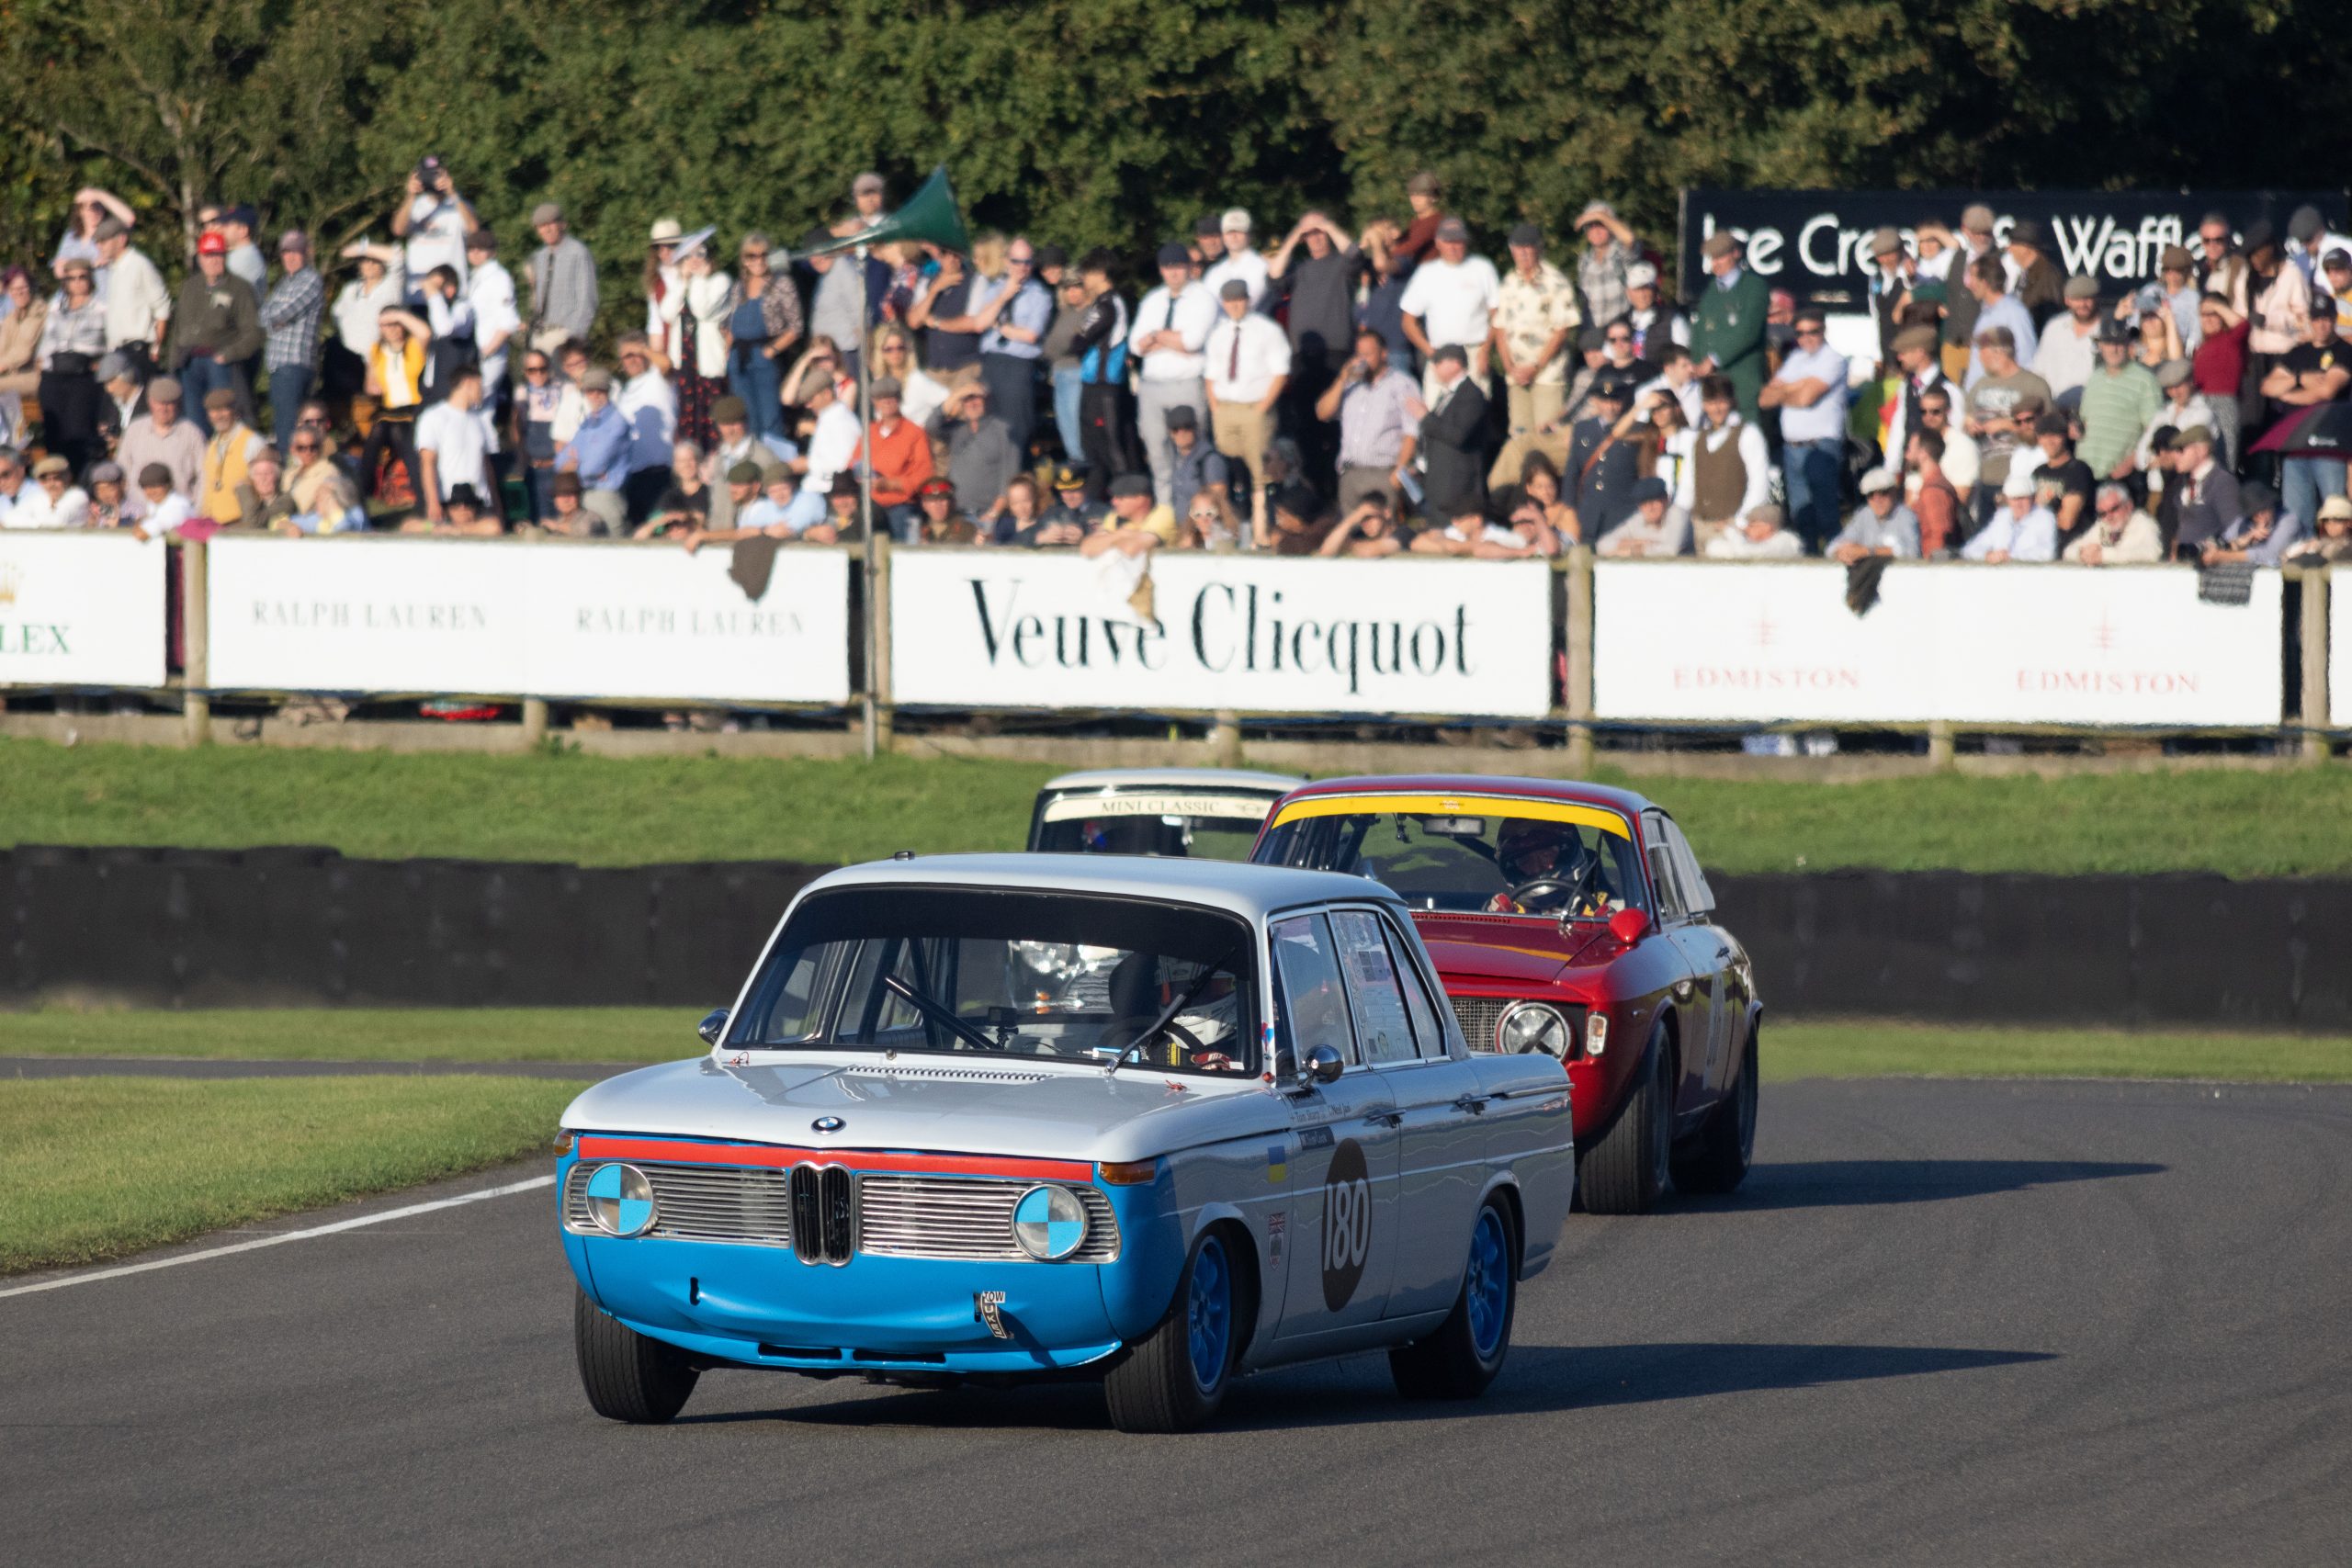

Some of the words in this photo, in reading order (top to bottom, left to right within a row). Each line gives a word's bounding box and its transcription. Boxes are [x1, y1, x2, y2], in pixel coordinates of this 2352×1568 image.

[1702, 212, 1784, 276] Ie
[251, 599, 351, 626] RALPH
[365, 603, 487, 631] LAUREN
[576, 606, 675, 634] RALPH
[691, 609, 804, 637] LAUREN
[965, 578, 1167, 669] Veuve
[1192, 581, 1474, 695] Clicquot
[1673, 666, 1860, 691] EDMISTON
[2016, 669, 2199, 694] EDMISTON
[1102, 802, 1144, 814] MINI
[1147, 801, 1220, 814] CLASSIC
[1323, 1178, 1370, 1271] 180
[983, 1292, 1005, 1303] TOW
